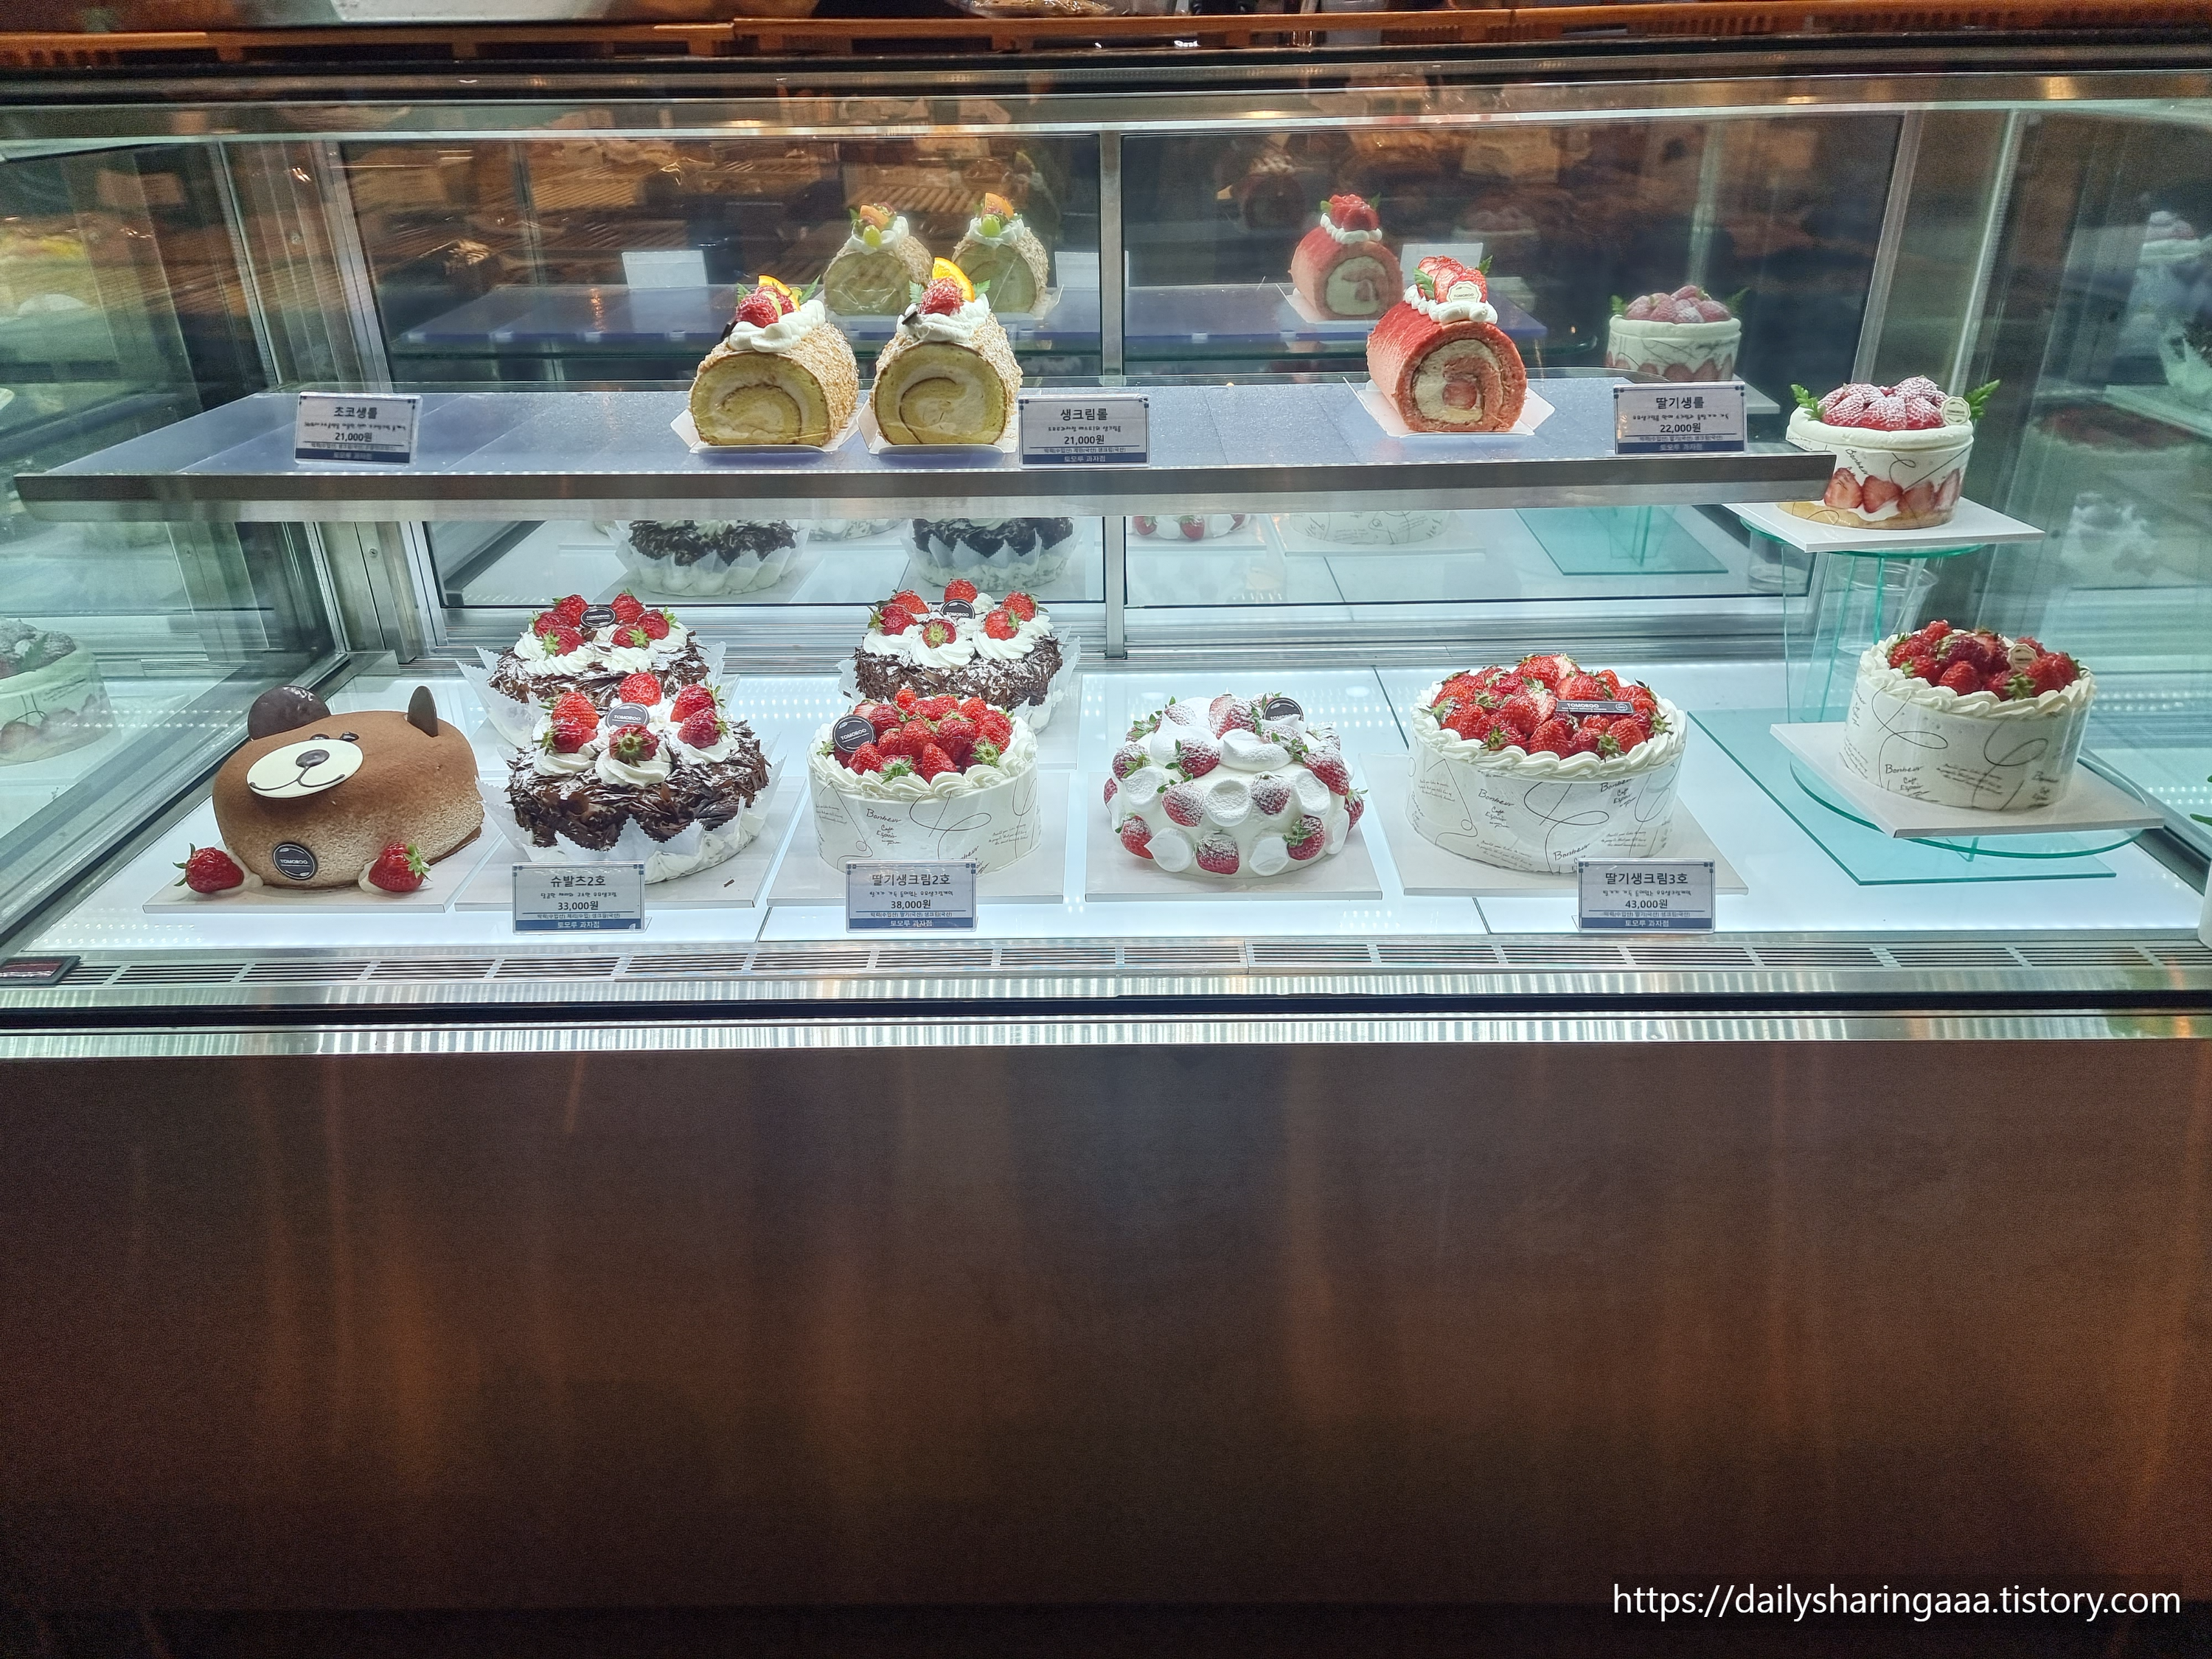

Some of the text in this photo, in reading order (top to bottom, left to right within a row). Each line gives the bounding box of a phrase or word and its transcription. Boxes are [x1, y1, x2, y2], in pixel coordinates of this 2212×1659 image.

[1060, 408, 1108, 421] 생크림롤
[1660, 422, 1701, 434] 22,000원
[335, 432, 372, 442] 21,000원
[1064, 435, 1105, 445] 21,000원
[840, 728, 867, 740] TOMOROO
[550, 875, 606, 888] 슈발츠2호
[872, 874, 951, 886] 딸기생크림2호
[1605, 872, 1688, 885] 딸기생크림3호
[557, 900, 599, 911] 33,000원
[891, 899, 931, 910] 38,000원
[1624, 899, 1668, 909] 43,000원
